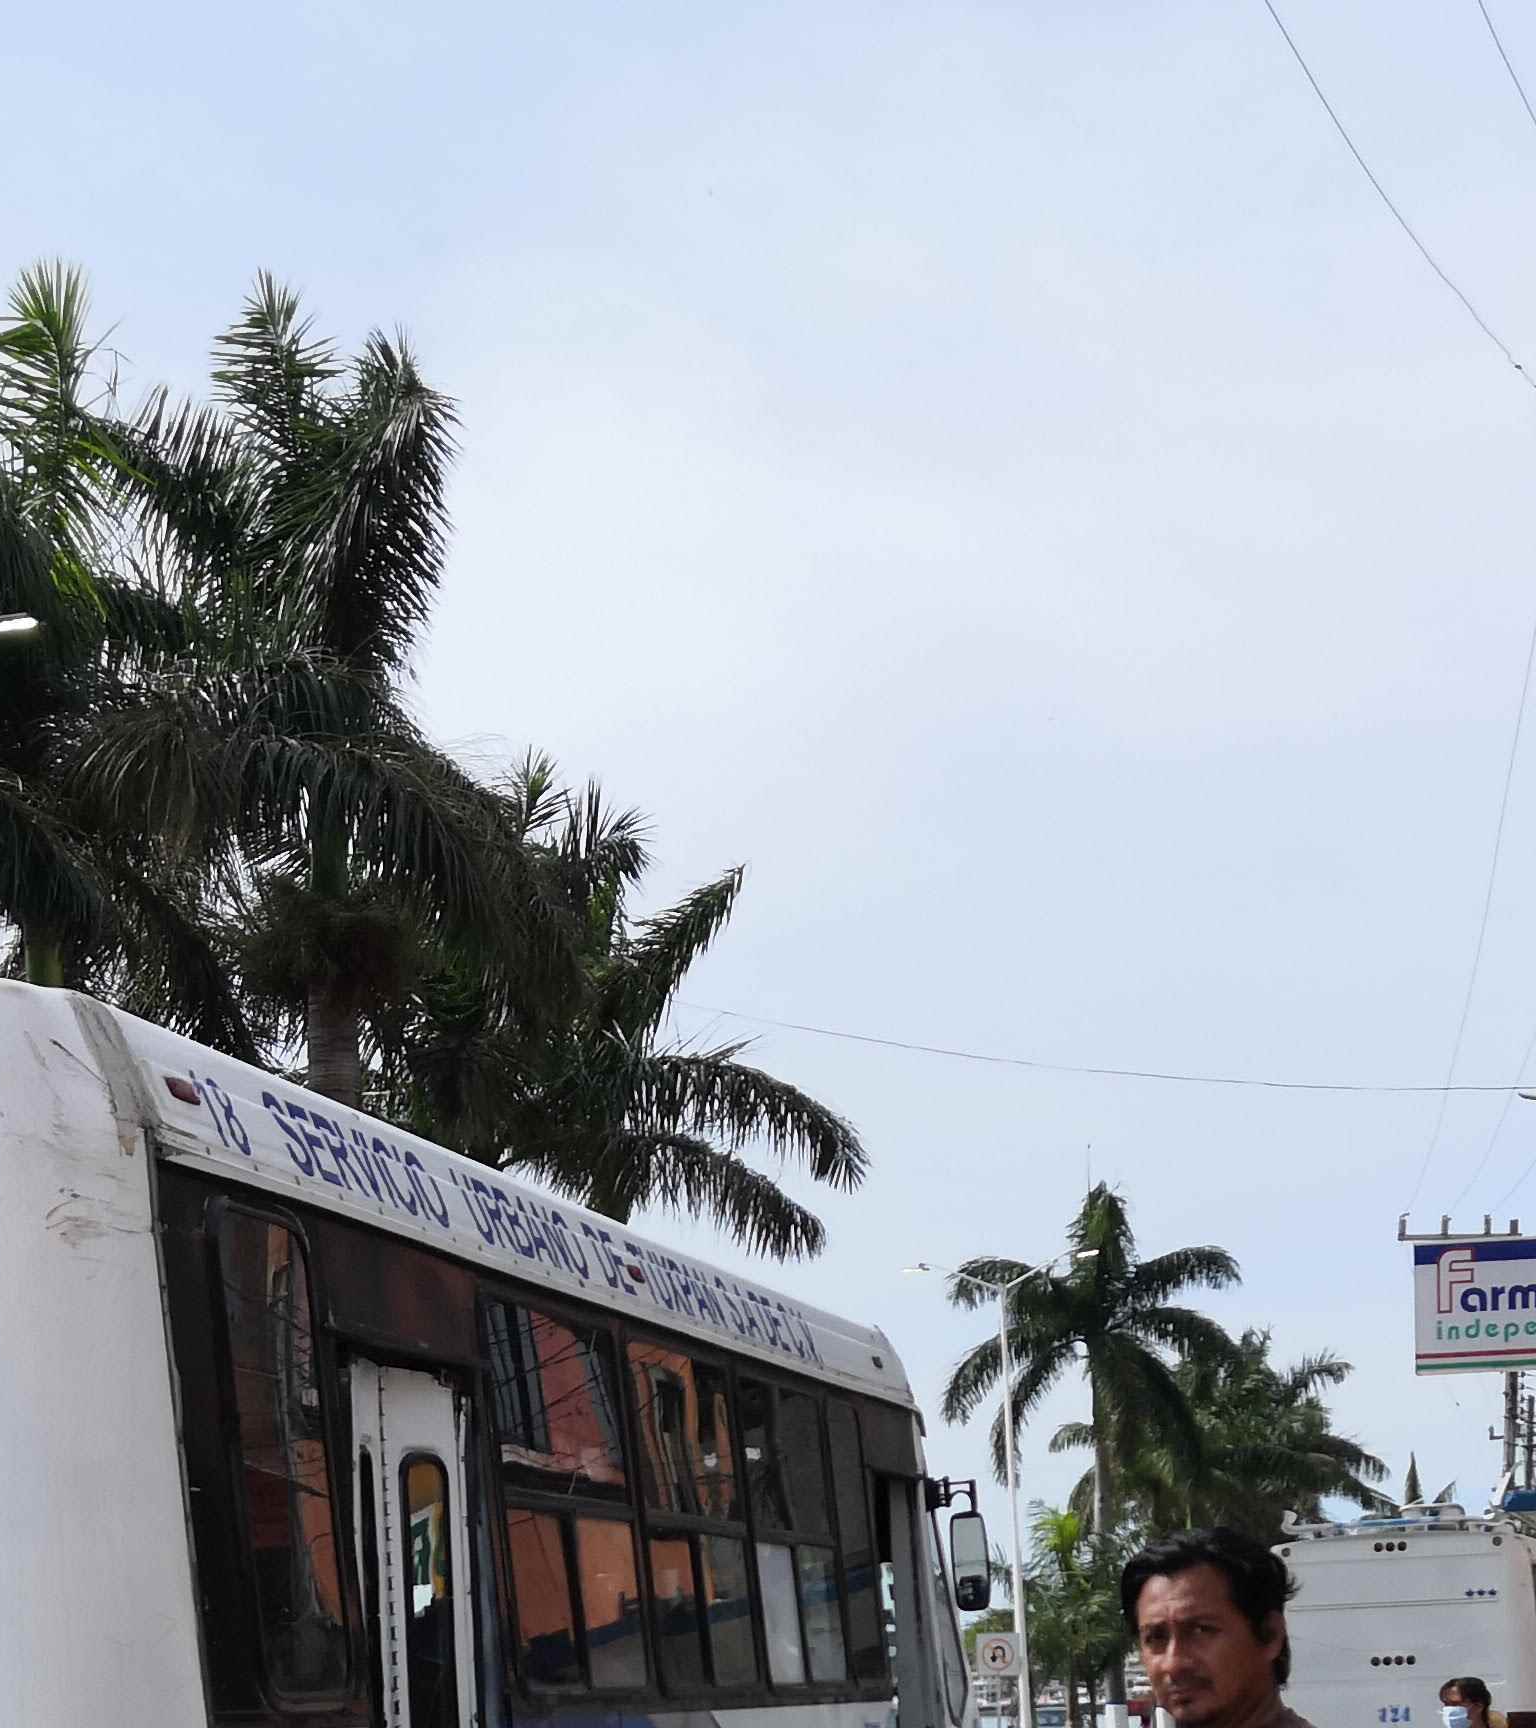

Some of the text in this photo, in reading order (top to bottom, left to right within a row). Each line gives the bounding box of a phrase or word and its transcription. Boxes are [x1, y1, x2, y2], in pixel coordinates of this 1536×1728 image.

[261, 1090, 450, 1229] SERVICIO
[448, 1167, 590, 1281] URBANO
[623, 1239, 729, 1330] TUXPAN
